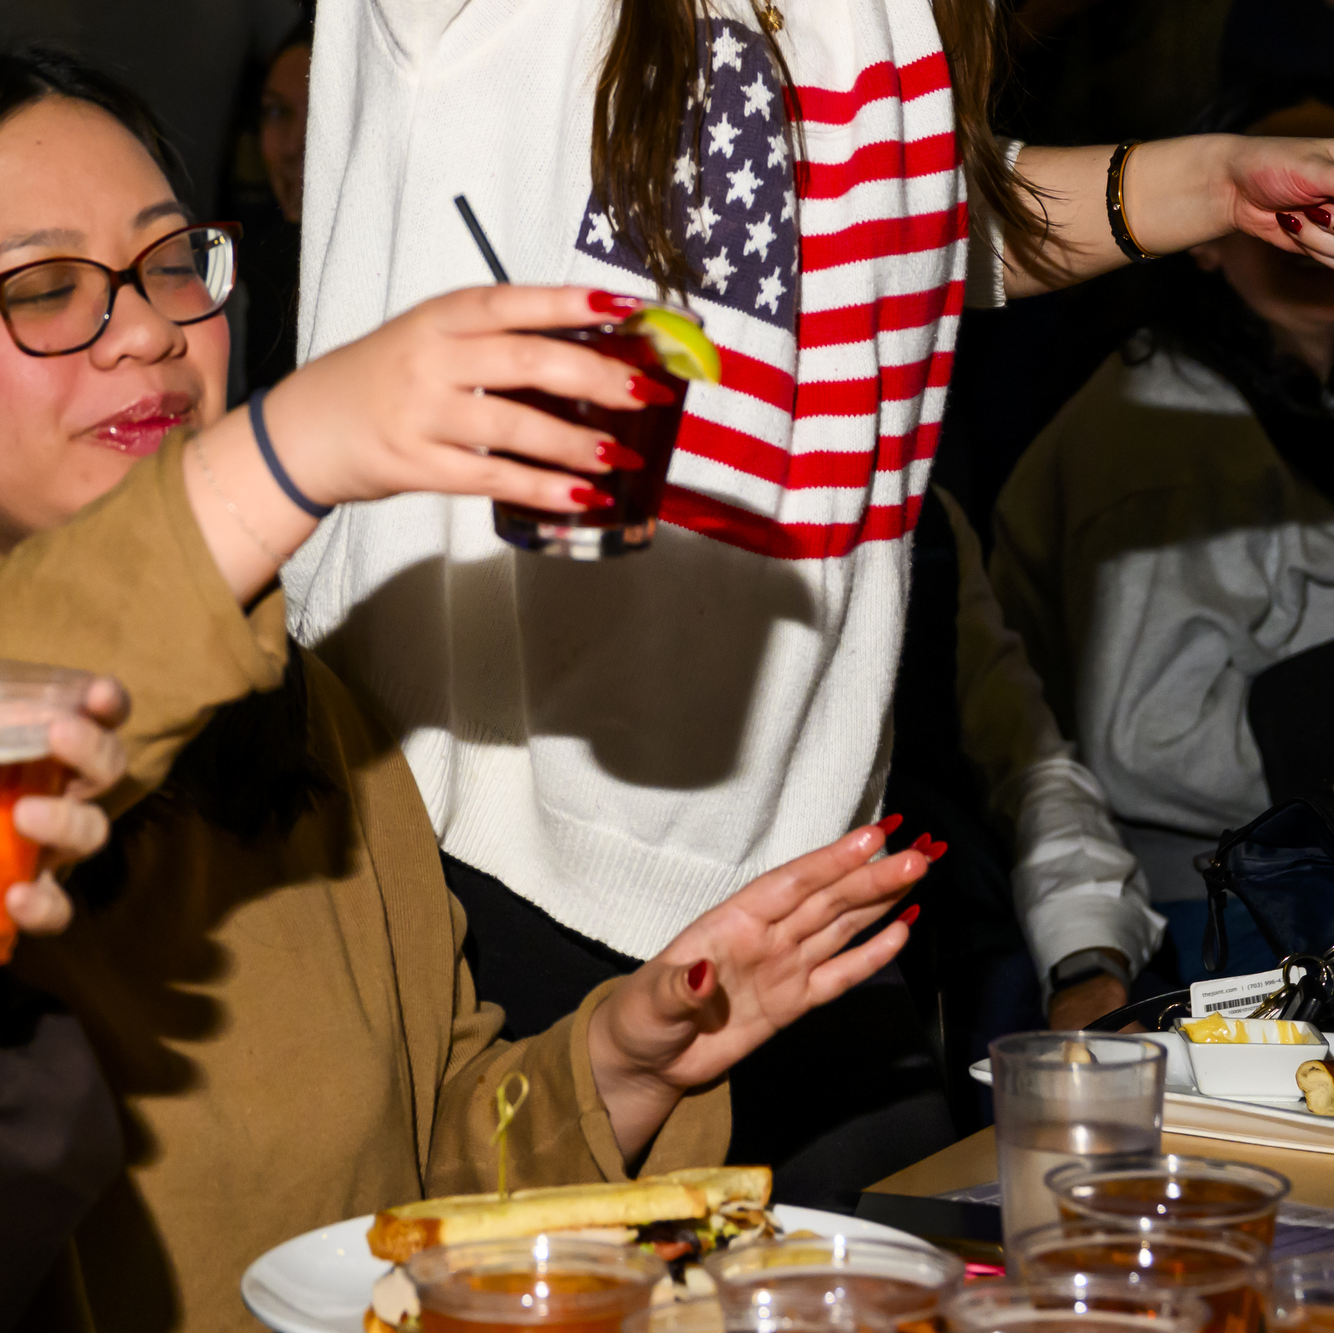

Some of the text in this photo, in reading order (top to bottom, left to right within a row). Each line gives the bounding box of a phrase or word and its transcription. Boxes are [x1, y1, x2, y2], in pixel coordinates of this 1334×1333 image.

[1201, 987, 1238, 998] thejoint.com
[1247, 981, 1263, 991] (703)
[1264, 978, 1285, 986] 996-4
